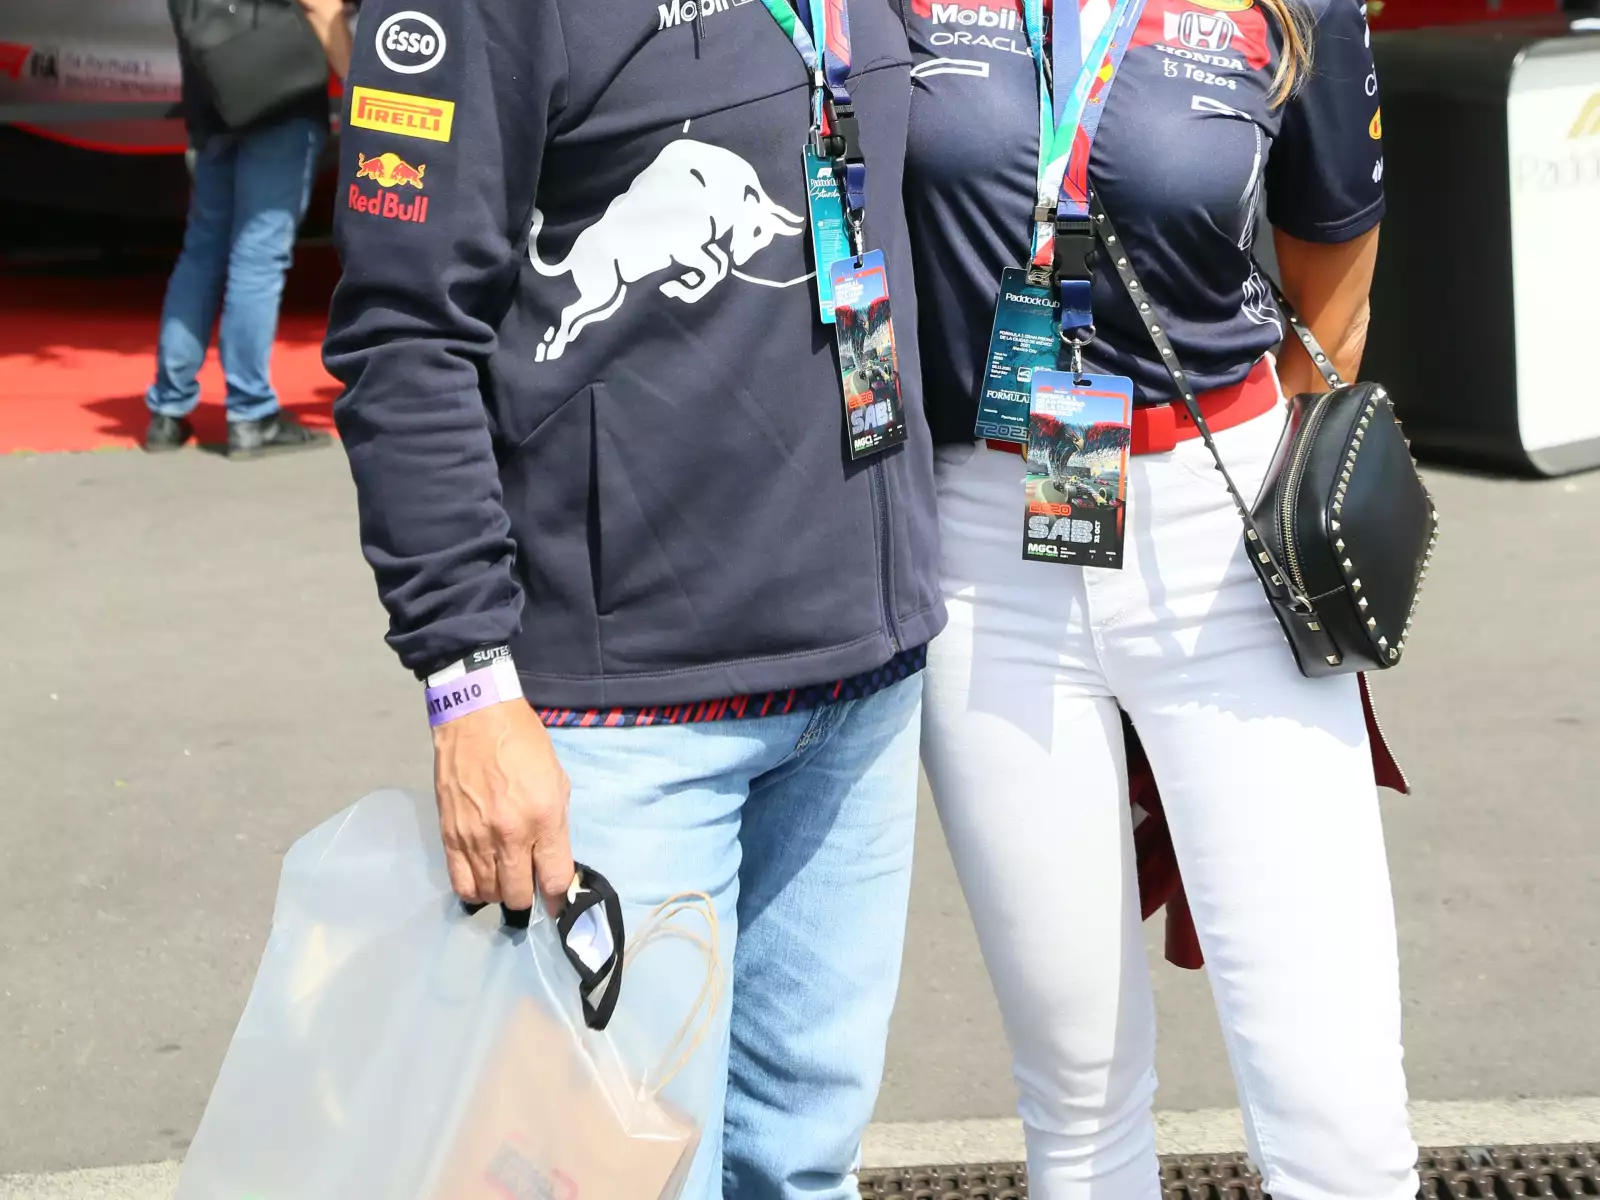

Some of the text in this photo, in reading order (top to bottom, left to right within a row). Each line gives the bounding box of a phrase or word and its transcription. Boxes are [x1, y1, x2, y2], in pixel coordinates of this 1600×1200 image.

[931, 3, 1016, 31] Mobil
[1154, 43, 1245, 72] HONDA
[1184, 62, 1237, 91] Tezos
[357, 96, 443, 132] PIRELLI
[1005, 292, 1060, 308] Paddock Club
[850, 400, 889, 436] SAB
[1027, 516, 1094, 544] SAB
